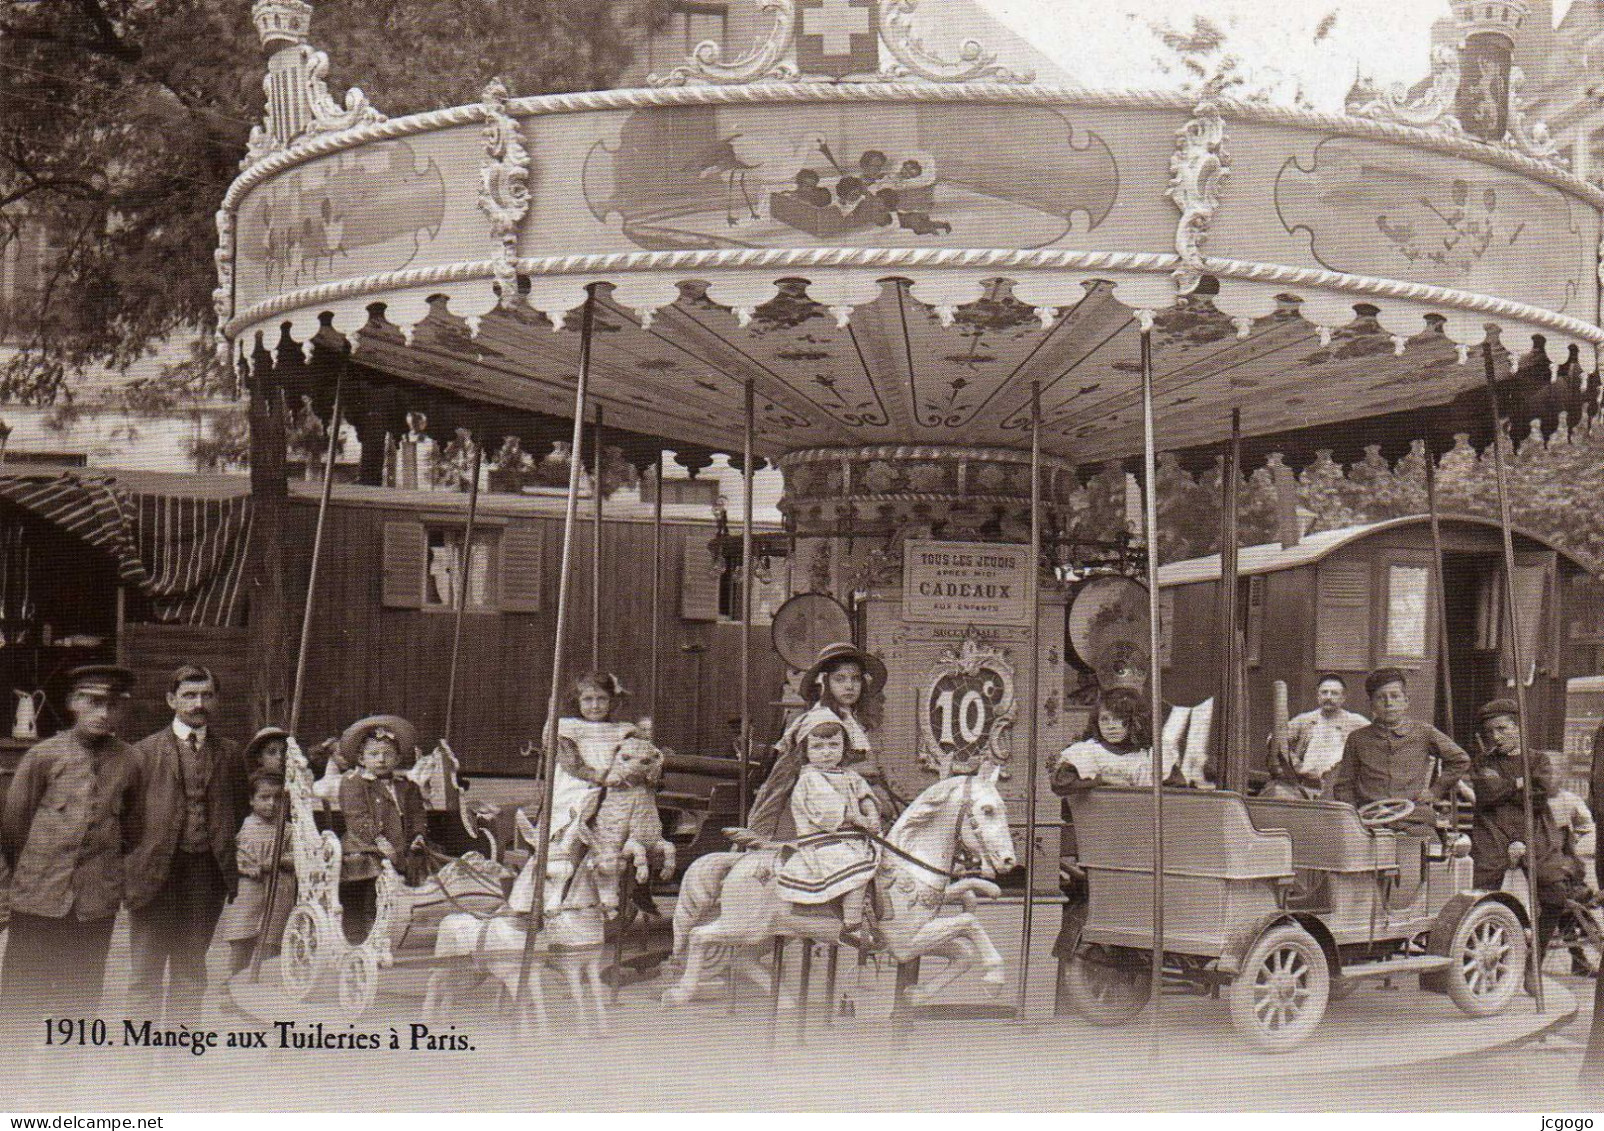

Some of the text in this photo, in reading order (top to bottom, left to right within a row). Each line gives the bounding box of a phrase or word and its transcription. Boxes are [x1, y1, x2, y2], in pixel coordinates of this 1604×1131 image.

[920, 553, 1016, 569] TOUS LES JEUDIS
[920, 582, 1011, 599] CADEAUX
